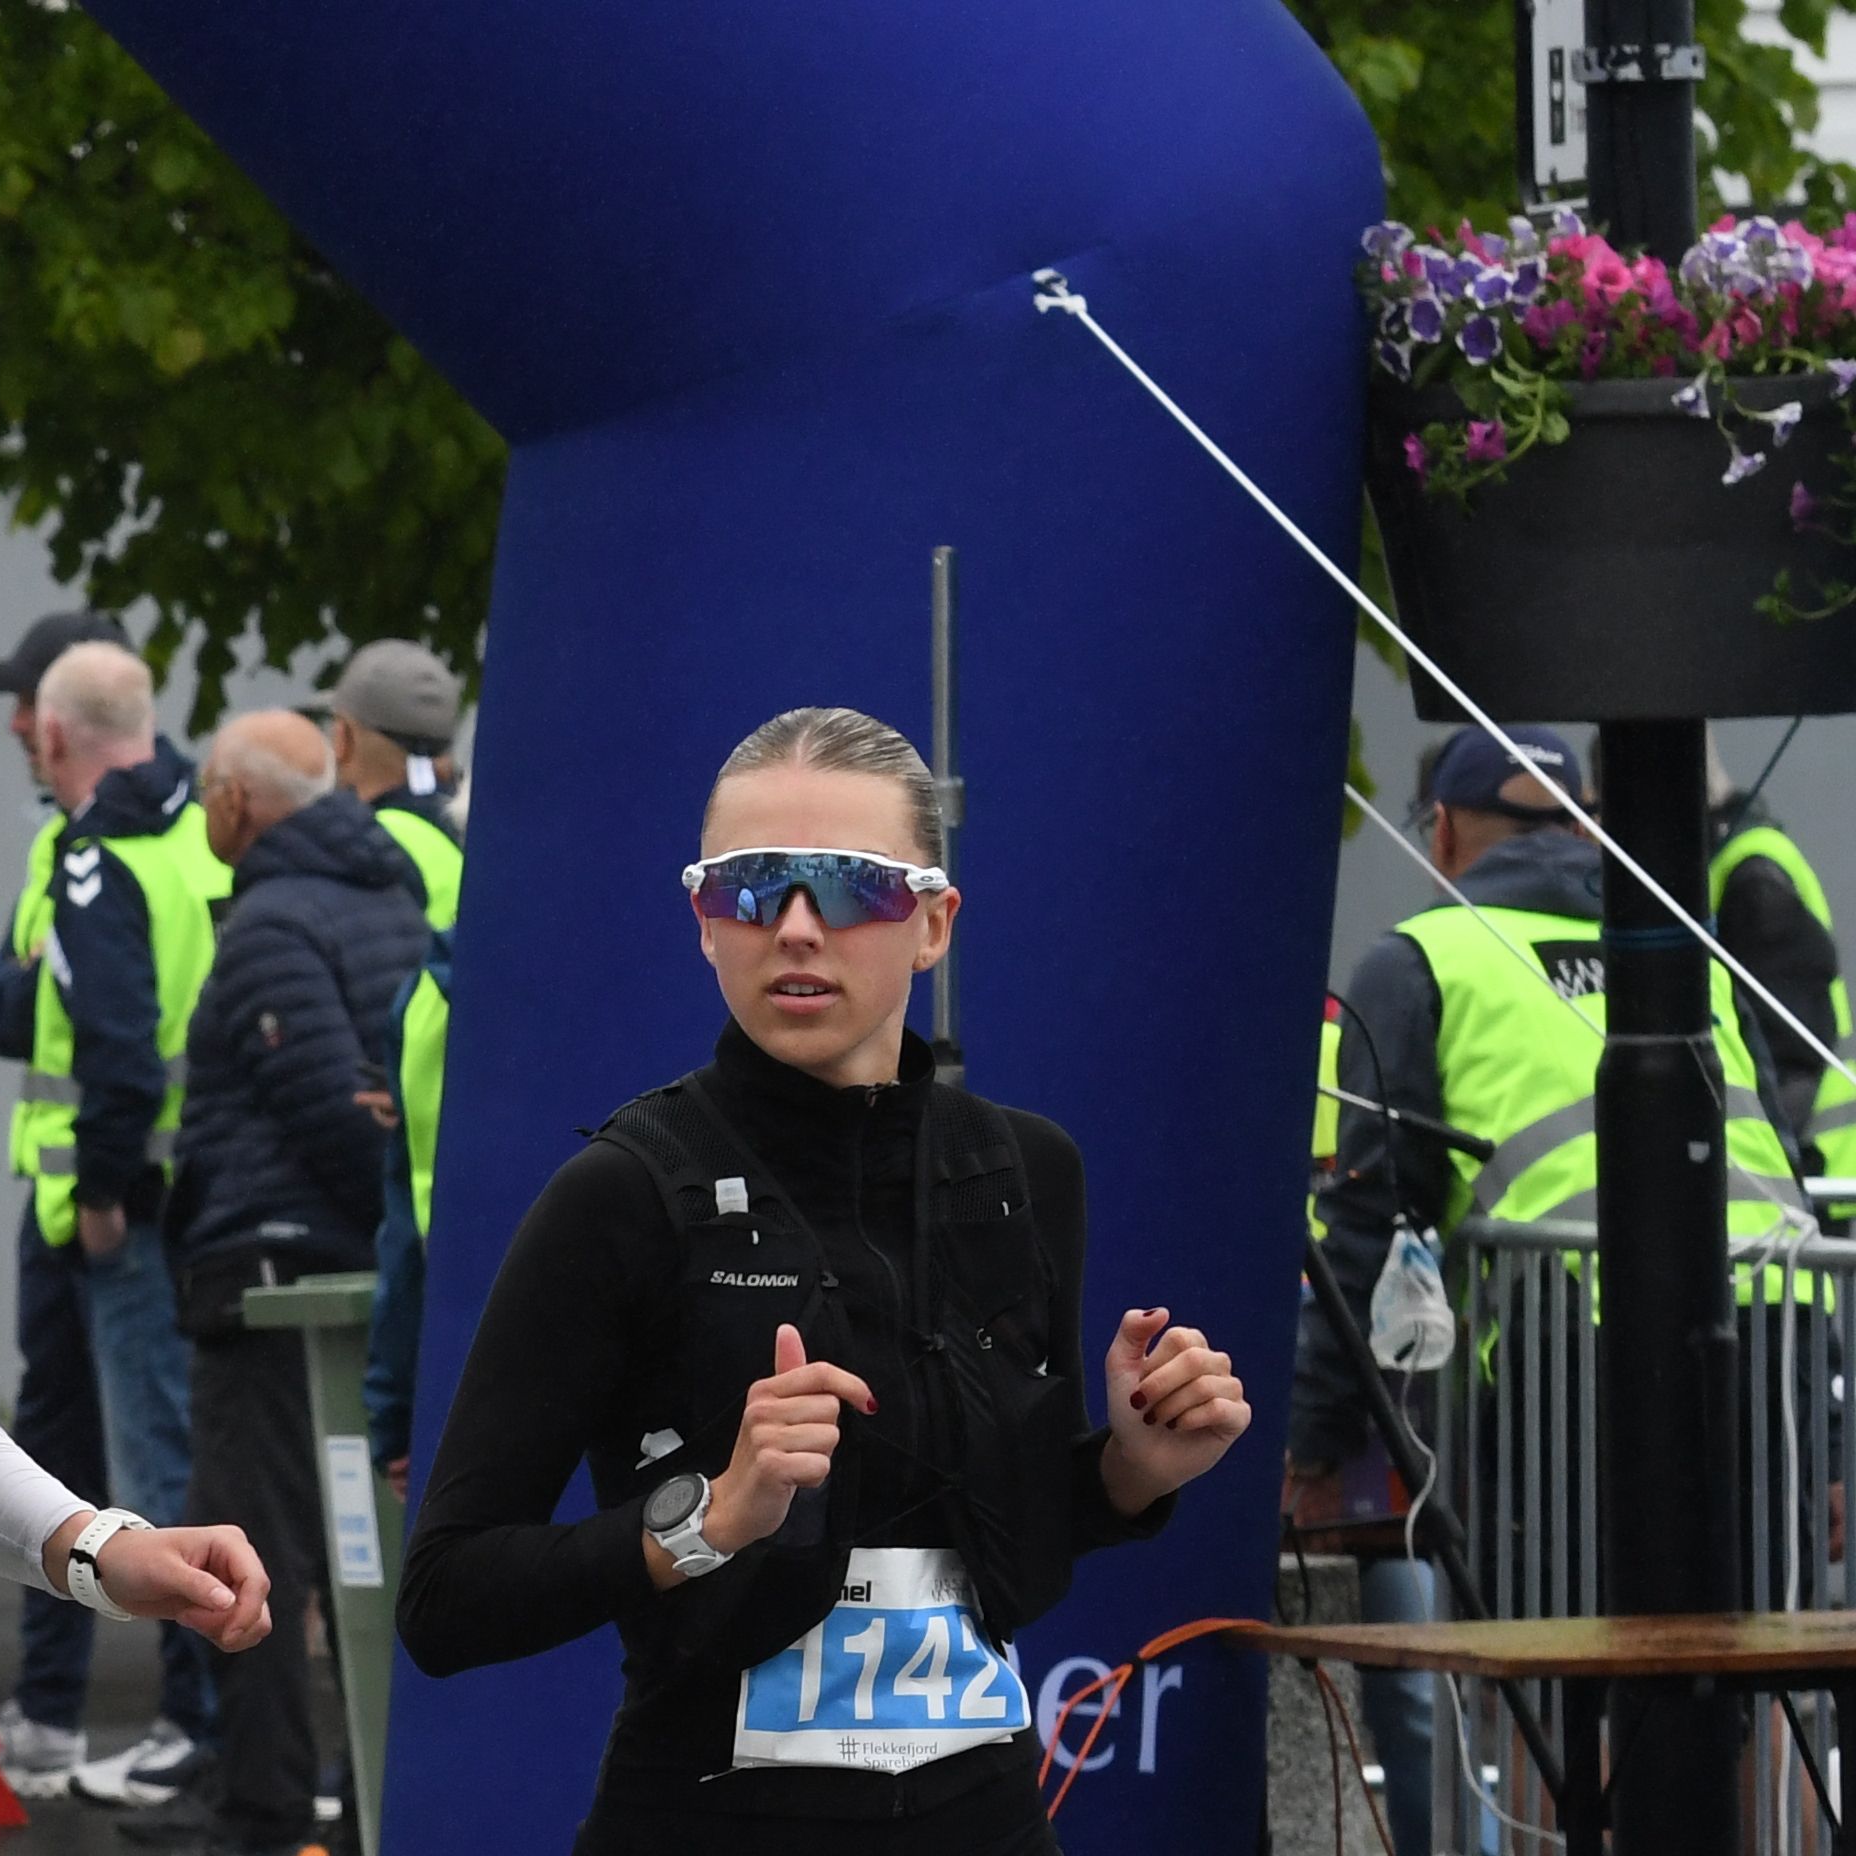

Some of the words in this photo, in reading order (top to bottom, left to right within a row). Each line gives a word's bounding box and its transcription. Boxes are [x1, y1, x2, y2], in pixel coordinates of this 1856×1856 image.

[710, 1270, 800, 1287] SALOMON
[788, 1614, 1007, 1723] 1142
[862, 1742, 939, 1757] Flekkefjord
